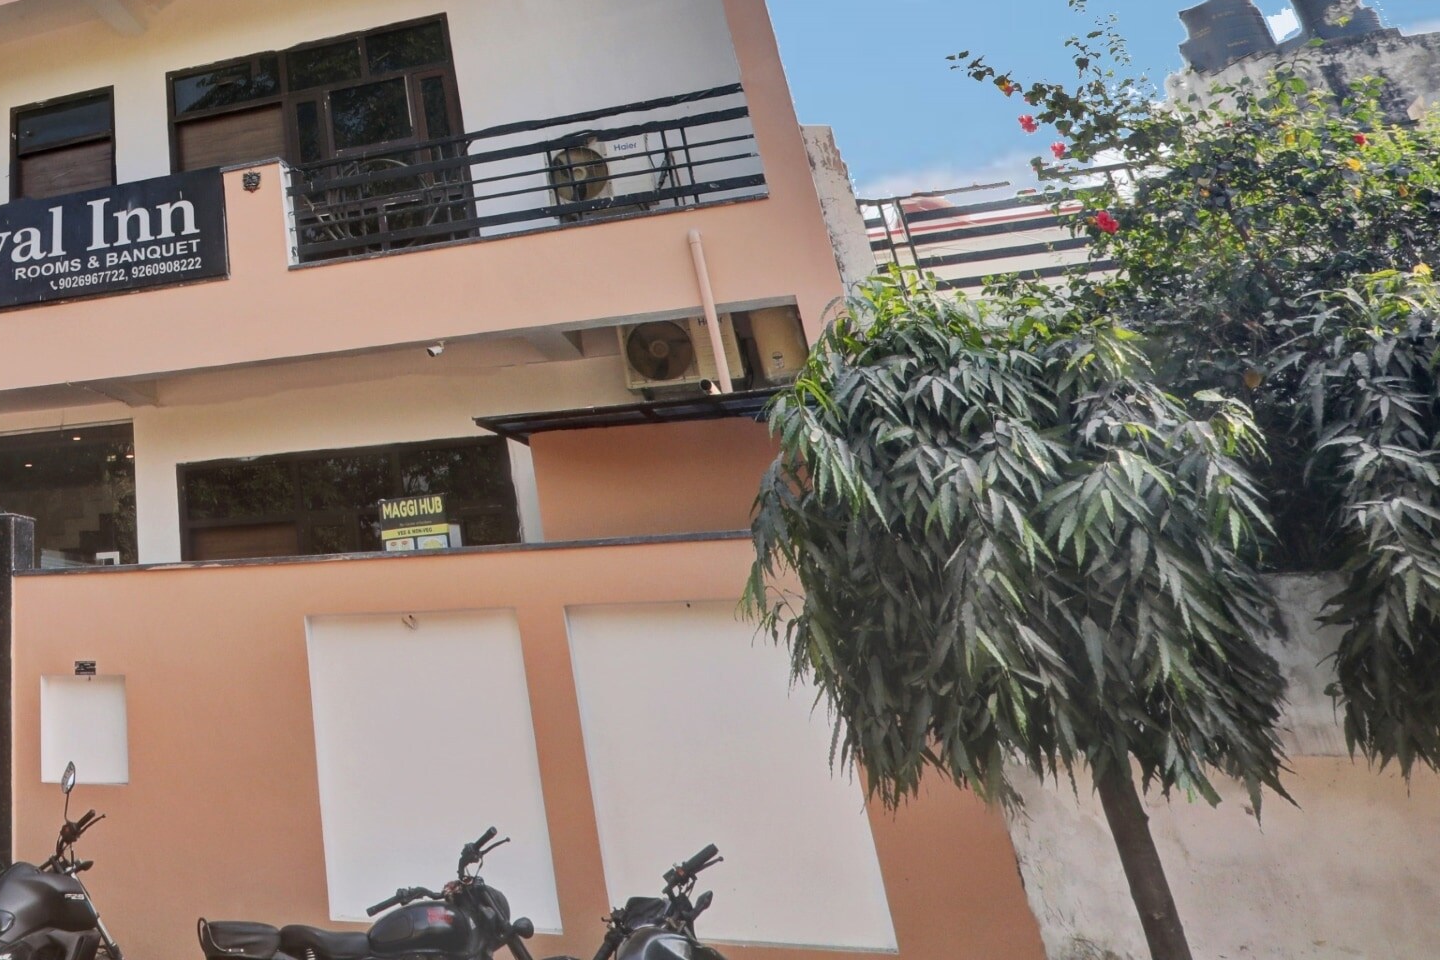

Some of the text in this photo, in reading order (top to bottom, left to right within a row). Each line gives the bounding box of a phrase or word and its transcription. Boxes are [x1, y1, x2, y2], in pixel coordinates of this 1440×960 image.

[614, 143, 637, 151] Haier
[86, 197, 200, 251] Inn
[15, 240, 201, 280] ROOMS & BANQUET
[59, 257, 202, 290] 9026967722, 9260908222
[382, 496, 443, 520] MAGGI HUB
